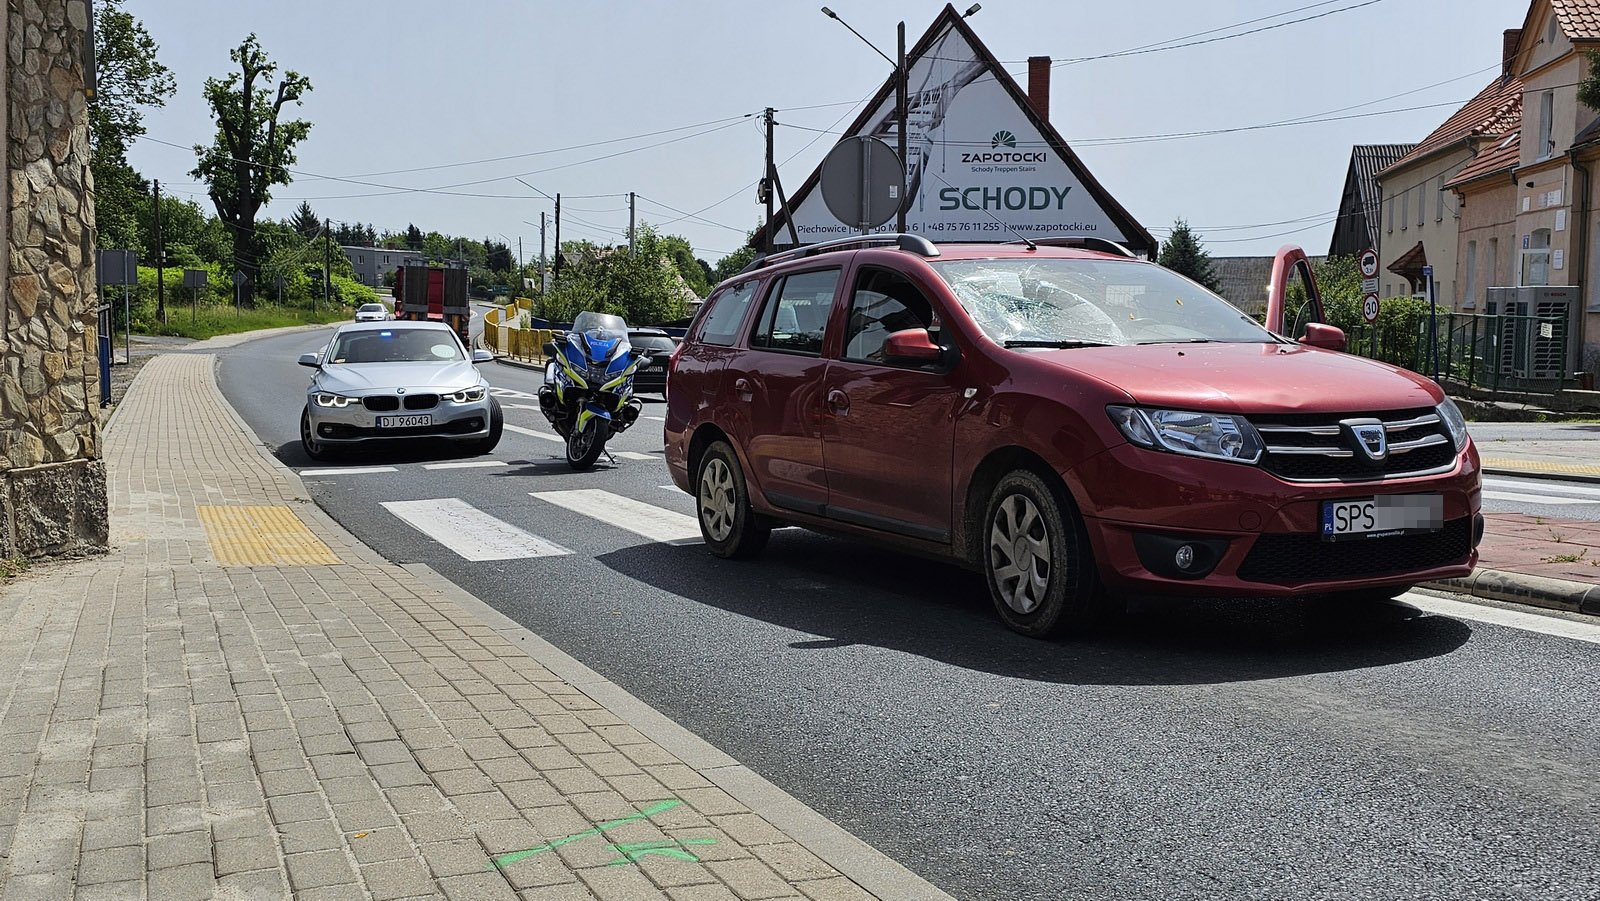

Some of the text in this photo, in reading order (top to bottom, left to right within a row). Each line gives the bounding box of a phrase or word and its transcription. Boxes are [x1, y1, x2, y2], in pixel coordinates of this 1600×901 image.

[962, 152, 1047, 162] ZAPOTOCKI
[939, 186, 1072, 210] SCHODY
[797, 224, 847, 233] Piechowice
[912, 222, 919, 231] 6
[927, 222, 944, 231] +48
[946, 222, 957, 231] 75
[959, 222, 970, 231] 76
[973, 222, 981, 231] 11
[983, 222, 1000, 231] 255
[1009, 222, 1097, 232] www.zapotocki.eu
[1366, 301, 1376, 315] 30
[383, 416, 429, 426] DJ 96043
[1335, 503, 1375, 531] SPS
[1324, 523, 1333, 531] PL
